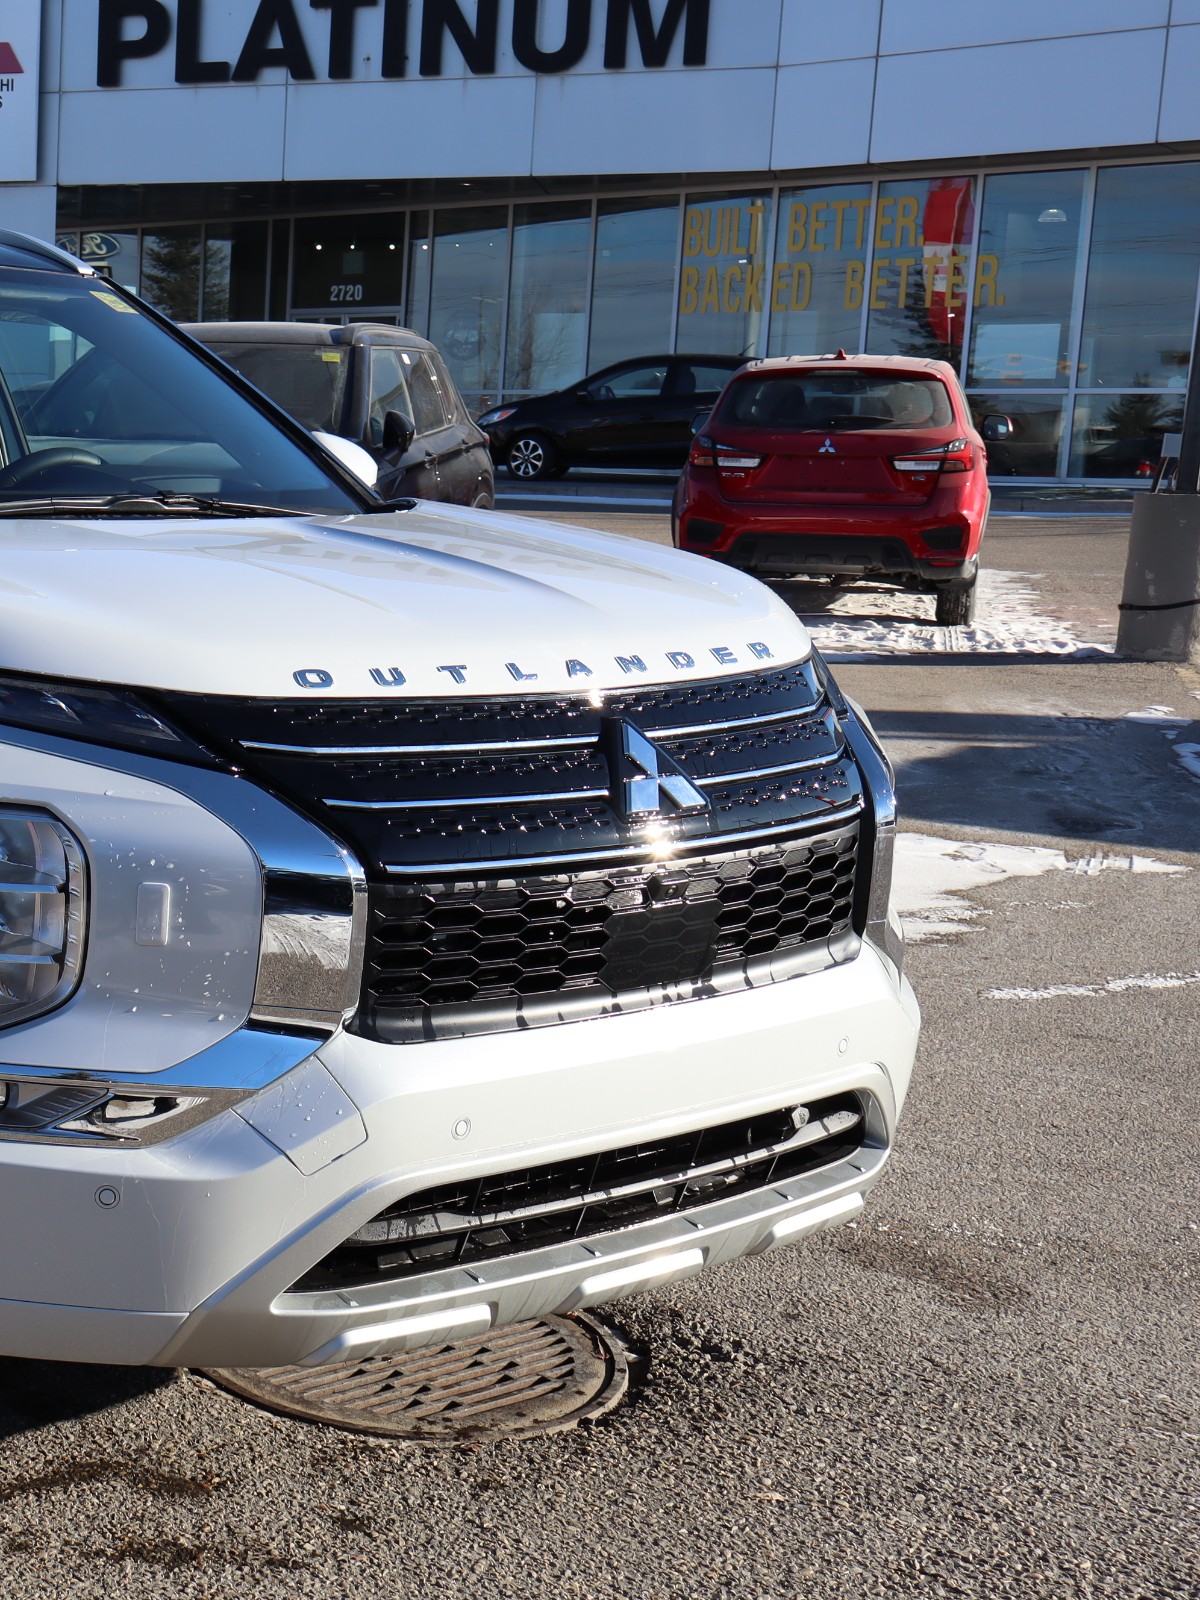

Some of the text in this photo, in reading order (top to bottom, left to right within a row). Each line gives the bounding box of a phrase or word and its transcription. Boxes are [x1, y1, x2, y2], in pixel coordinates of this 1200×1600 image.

[97, 0, 708, 87] PLATINUM
[684, 196, 925, 257] BUILT BETTER.
[330, 284, 363, 301] 2720
[679, 255, 1006, 314] BACKED BETTER.
[292, 641, 776, 689] OUTLANDER
